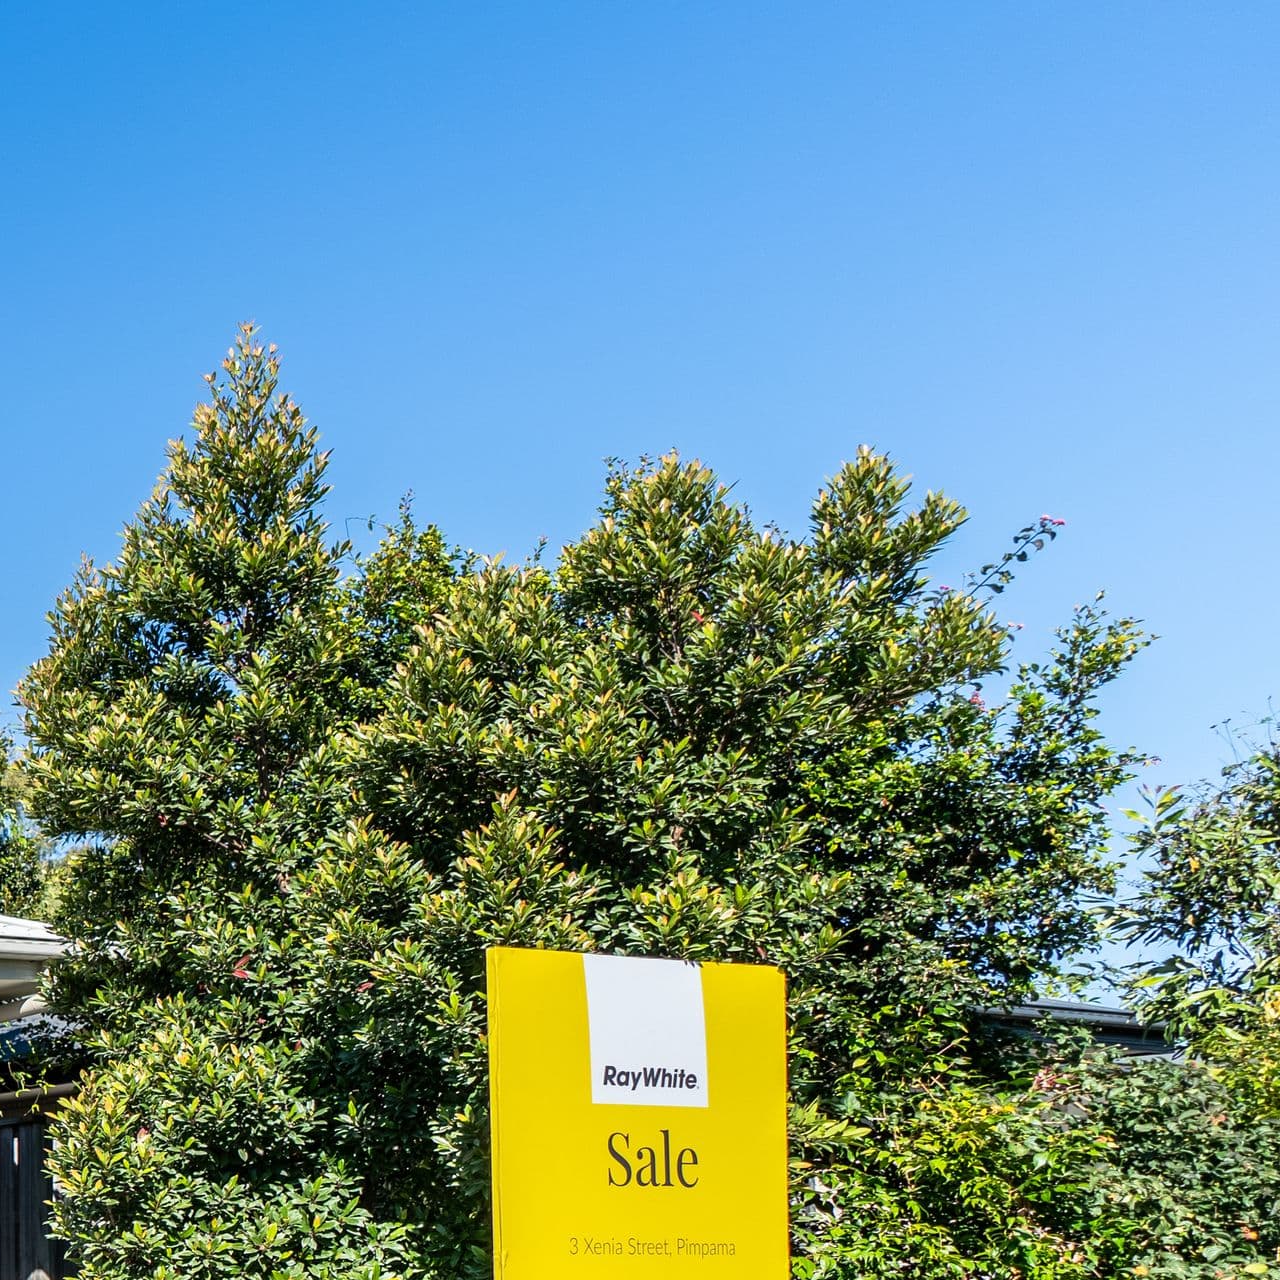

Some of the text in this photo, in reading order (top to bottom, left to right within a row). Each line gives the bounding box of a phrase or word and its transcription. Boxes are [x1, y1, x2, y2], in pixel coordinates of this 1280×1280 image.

[607, 1129, 699, 1188] Sale
[569, 1237, 736, 1259] 3 Xenia Street, Pimpama
